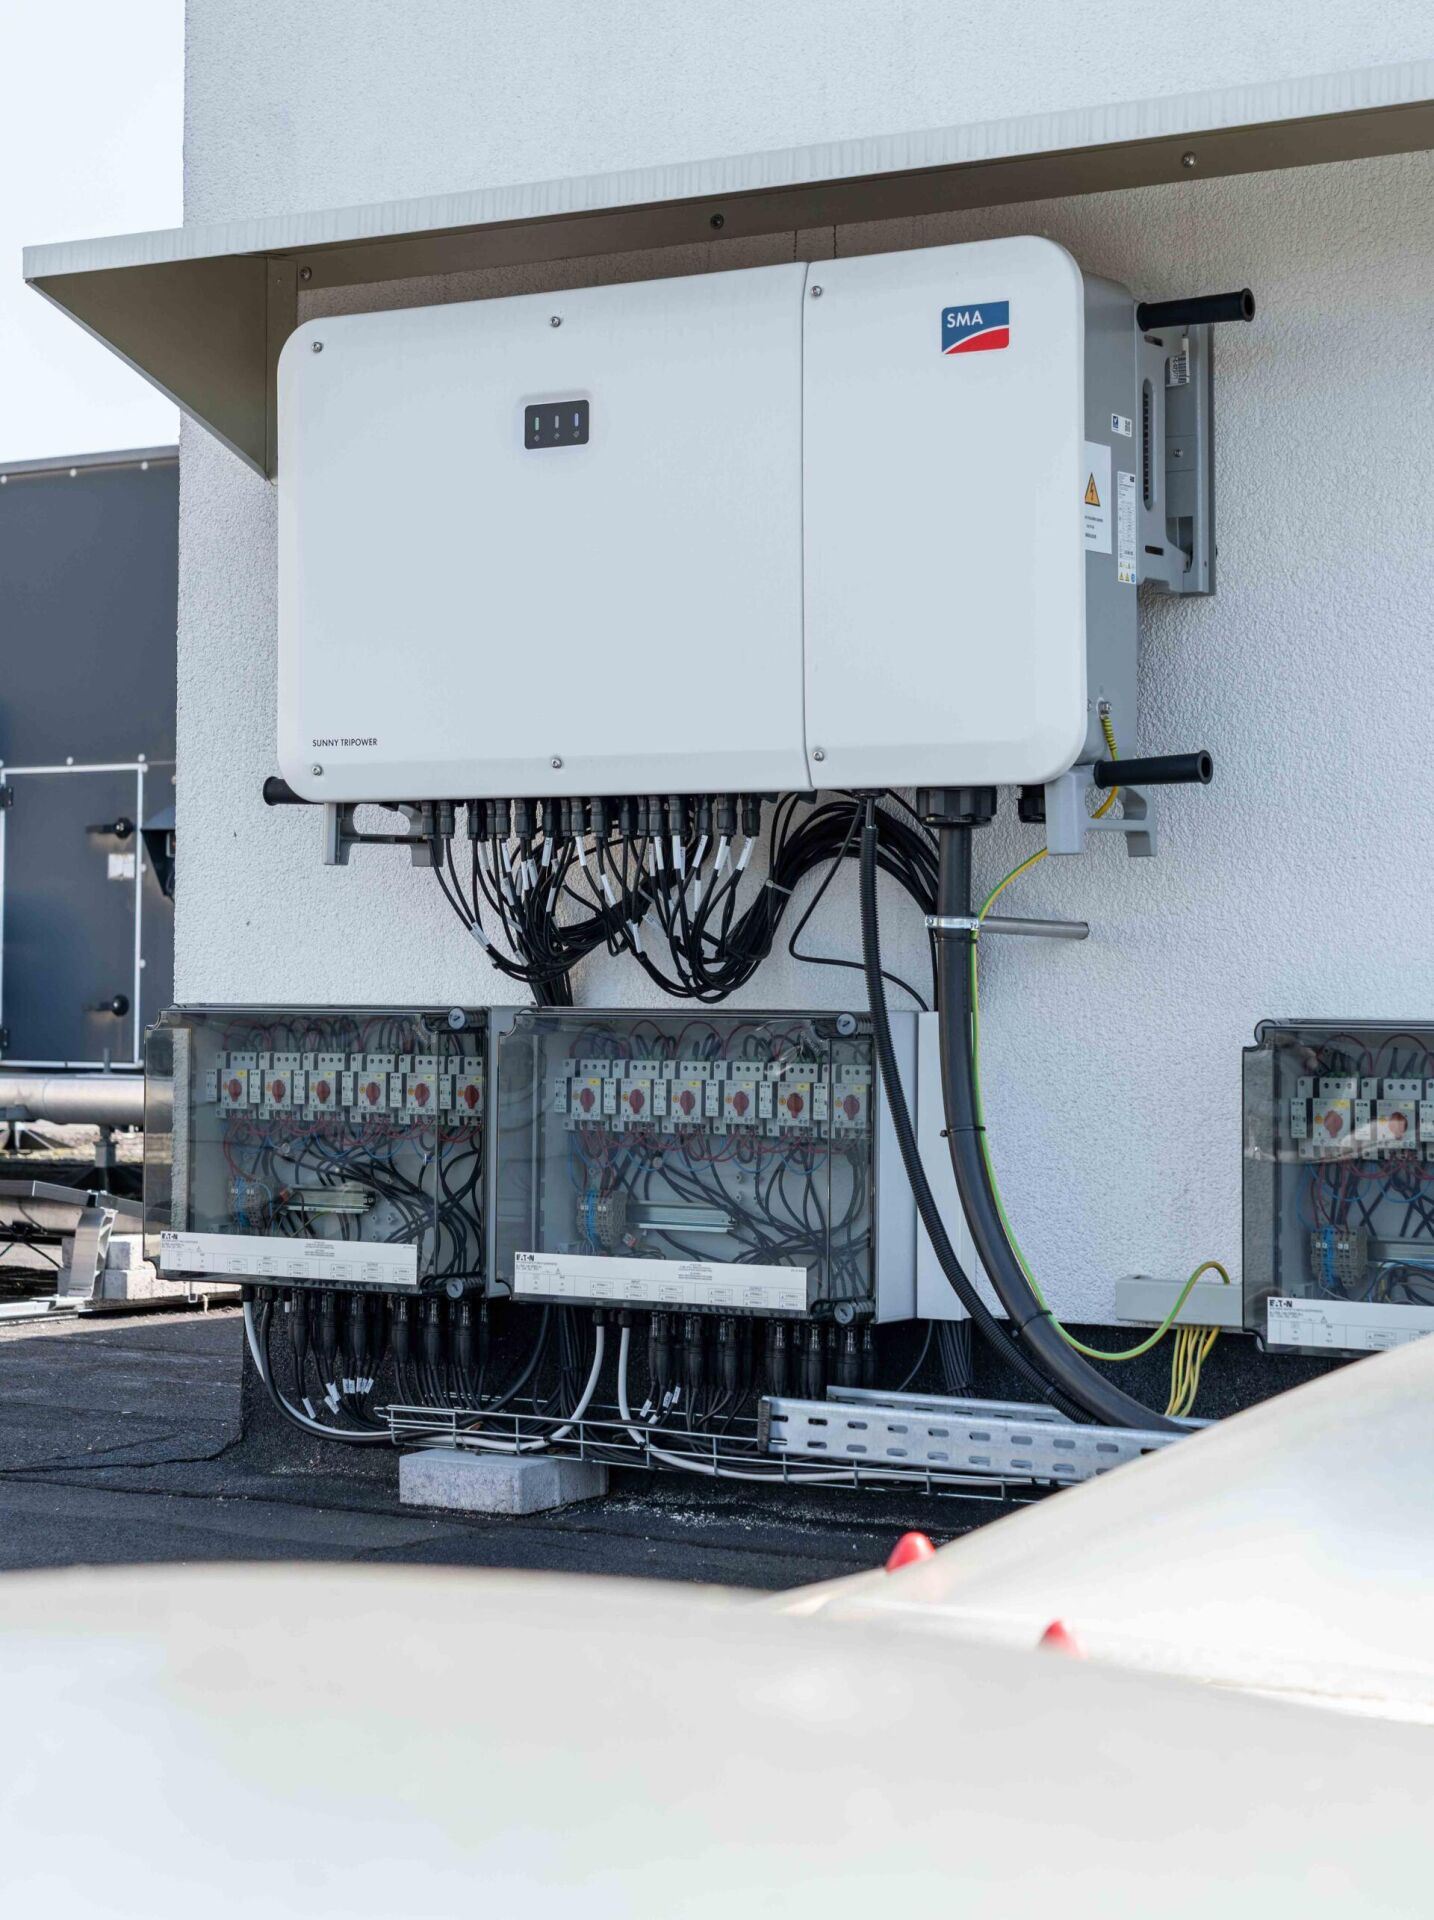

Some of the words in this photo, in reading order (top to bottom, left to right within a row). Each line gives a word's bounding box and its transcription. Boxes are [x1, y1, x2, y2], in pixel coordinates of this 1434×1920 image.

[946, 309, 983, 328] SMA
[312, 739, 339, 747] SUNNY
[341, 738, 378, 747] TRIPOWER
